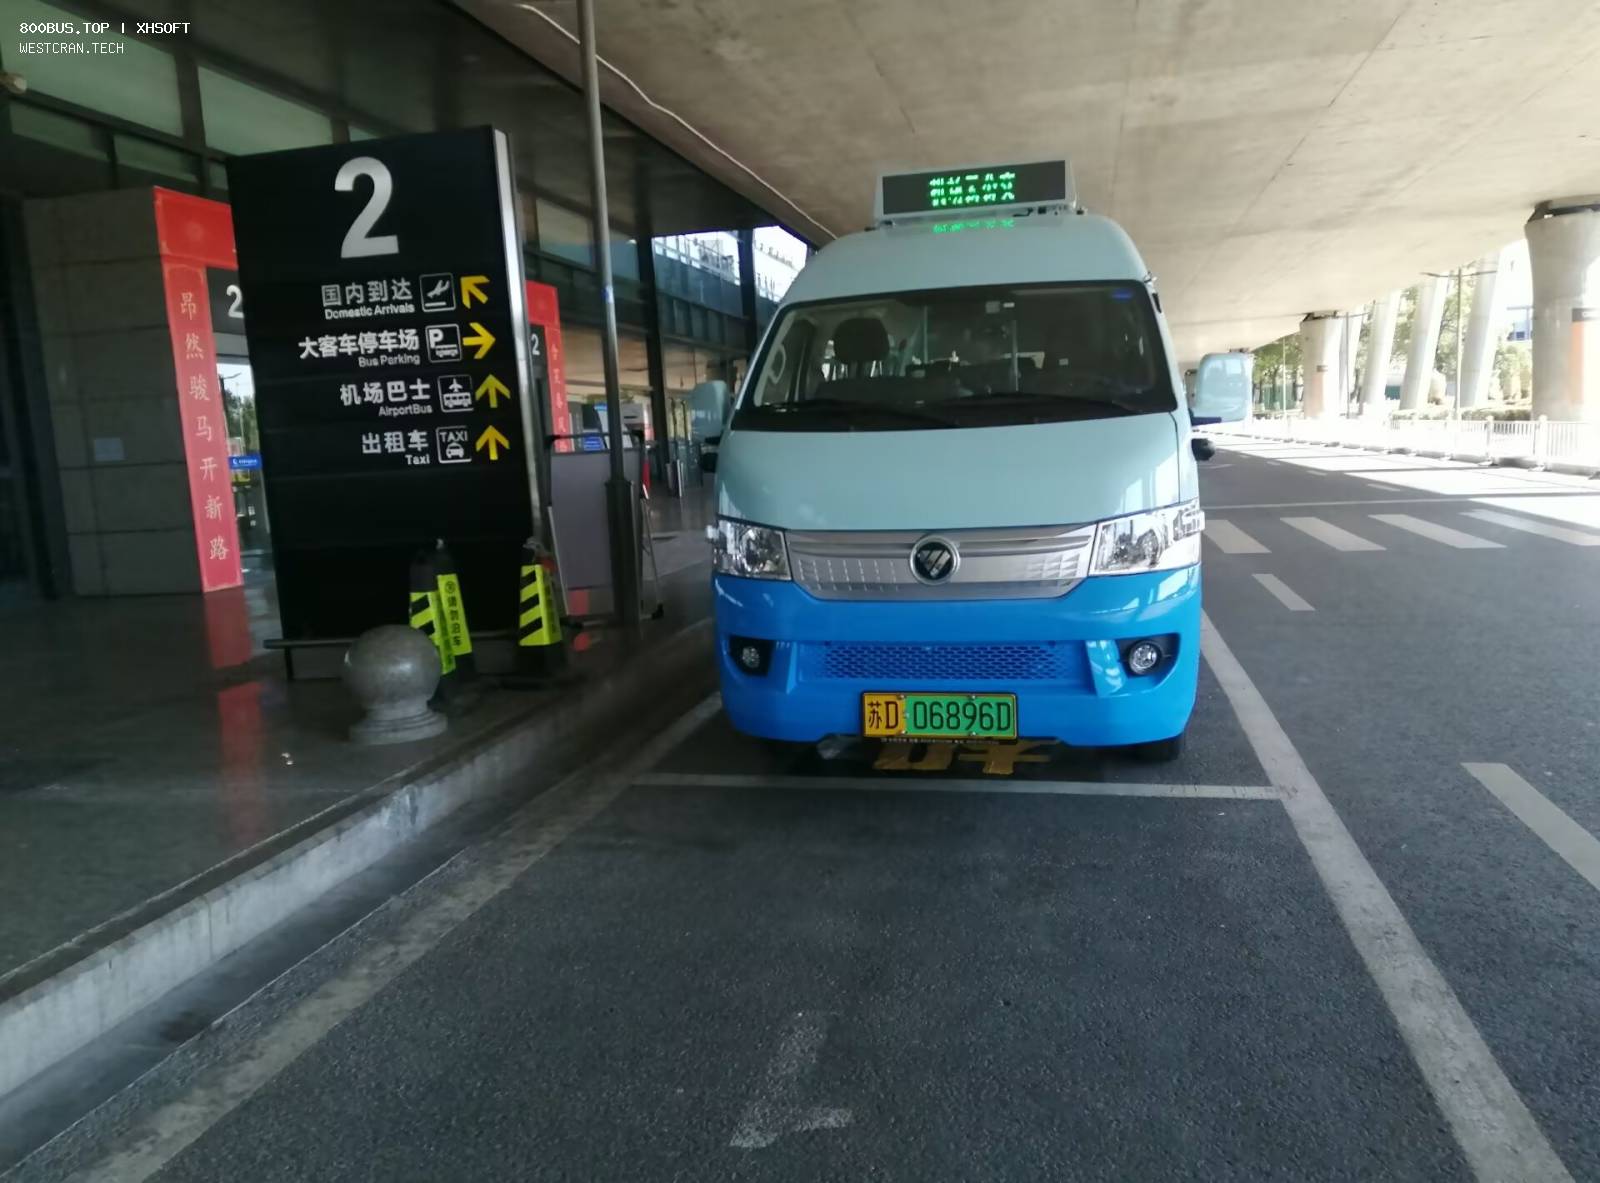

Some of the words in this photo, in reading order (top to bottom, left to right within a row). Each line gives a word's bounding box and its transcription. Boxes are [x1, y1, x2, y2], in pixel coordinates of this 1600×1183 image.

[333, 155, 400, 258] 2
[226, 284, 245, 319] 2
[321, 277, 413, 307] 国内到达
[324, 305, 373, 320] Domestic
[374, 302, 415, 316] Arrivals
[298, 328, 420, 359] 大客车停车场
[531, 333, 541, 356] 2
[358, 356, 379, 368] Bus
[380, 353, 421, 367] Parking
[339, 377, 431, 407] 机场巴士
[180, 291, 231, 561] 昂然骏马开新路
[439, 431, 468, 443] TAXI
[361, 429, 429, 454] 出租车
[405, 453, 431, 466] Taxi
